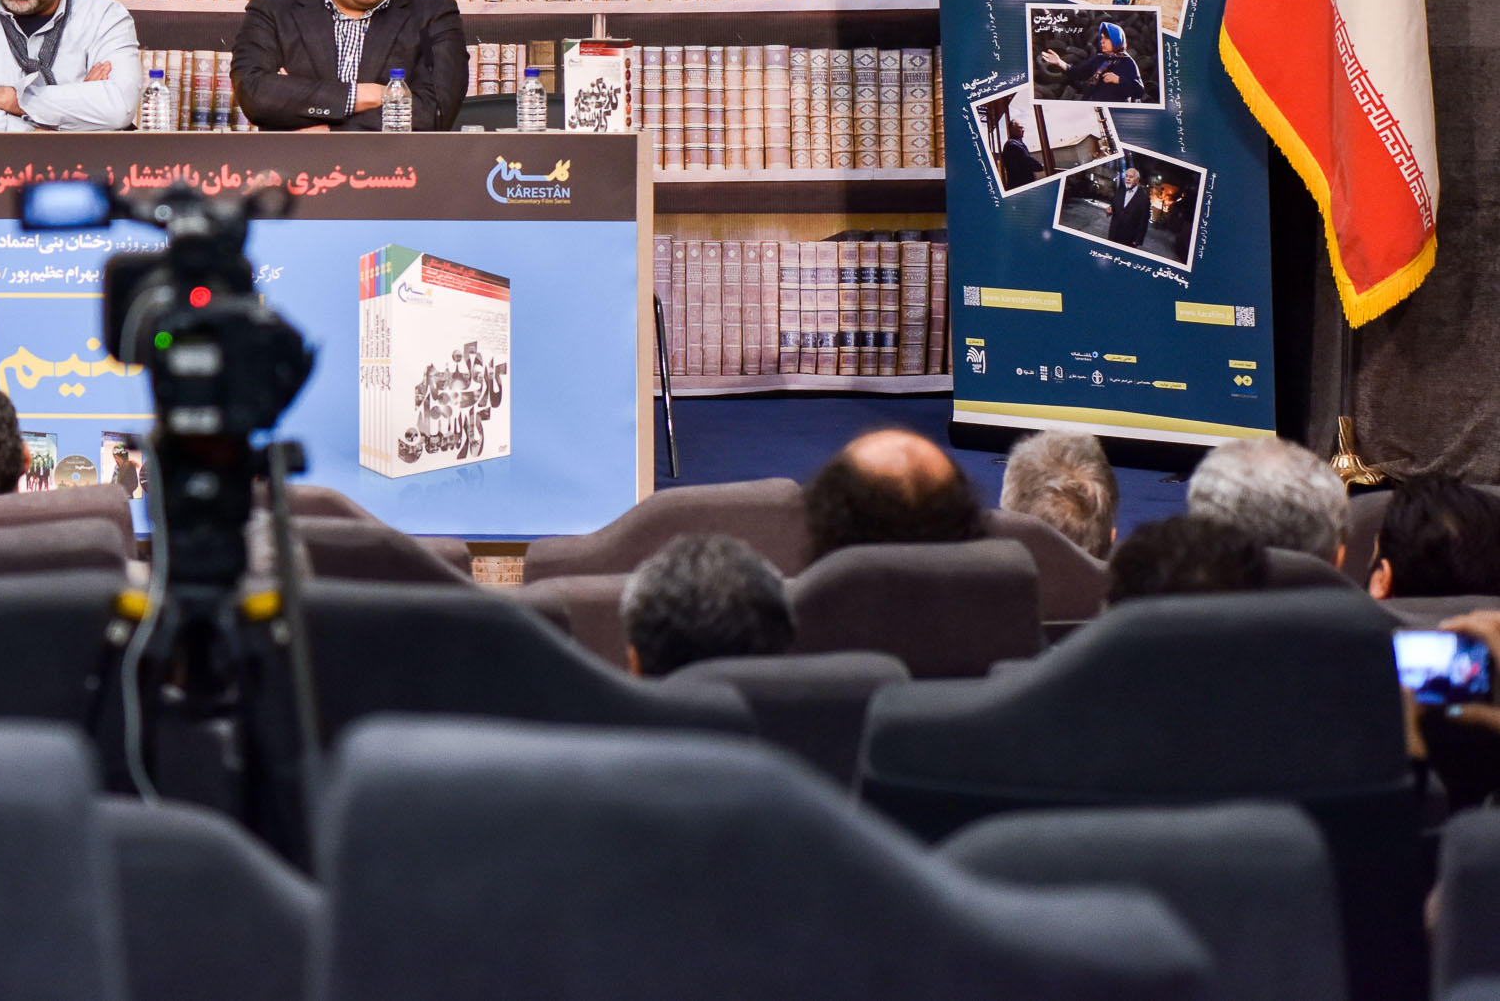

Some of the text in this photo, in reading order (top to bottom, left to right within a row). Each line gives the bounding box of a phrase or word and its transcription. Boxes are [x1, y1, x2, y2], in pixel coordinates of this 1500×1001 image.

[1051, 12, 1069, 25] مادر
[118, 163, 181, 196] انتشار
[286, 165, 348, 195] خبری
[349, 165, 417, 189] نشست
[506, 183, 571, 198] KÂRESTÂN
[65, 235, 112, 251] رخشان
[65, 265, 100, 284] بهرام
